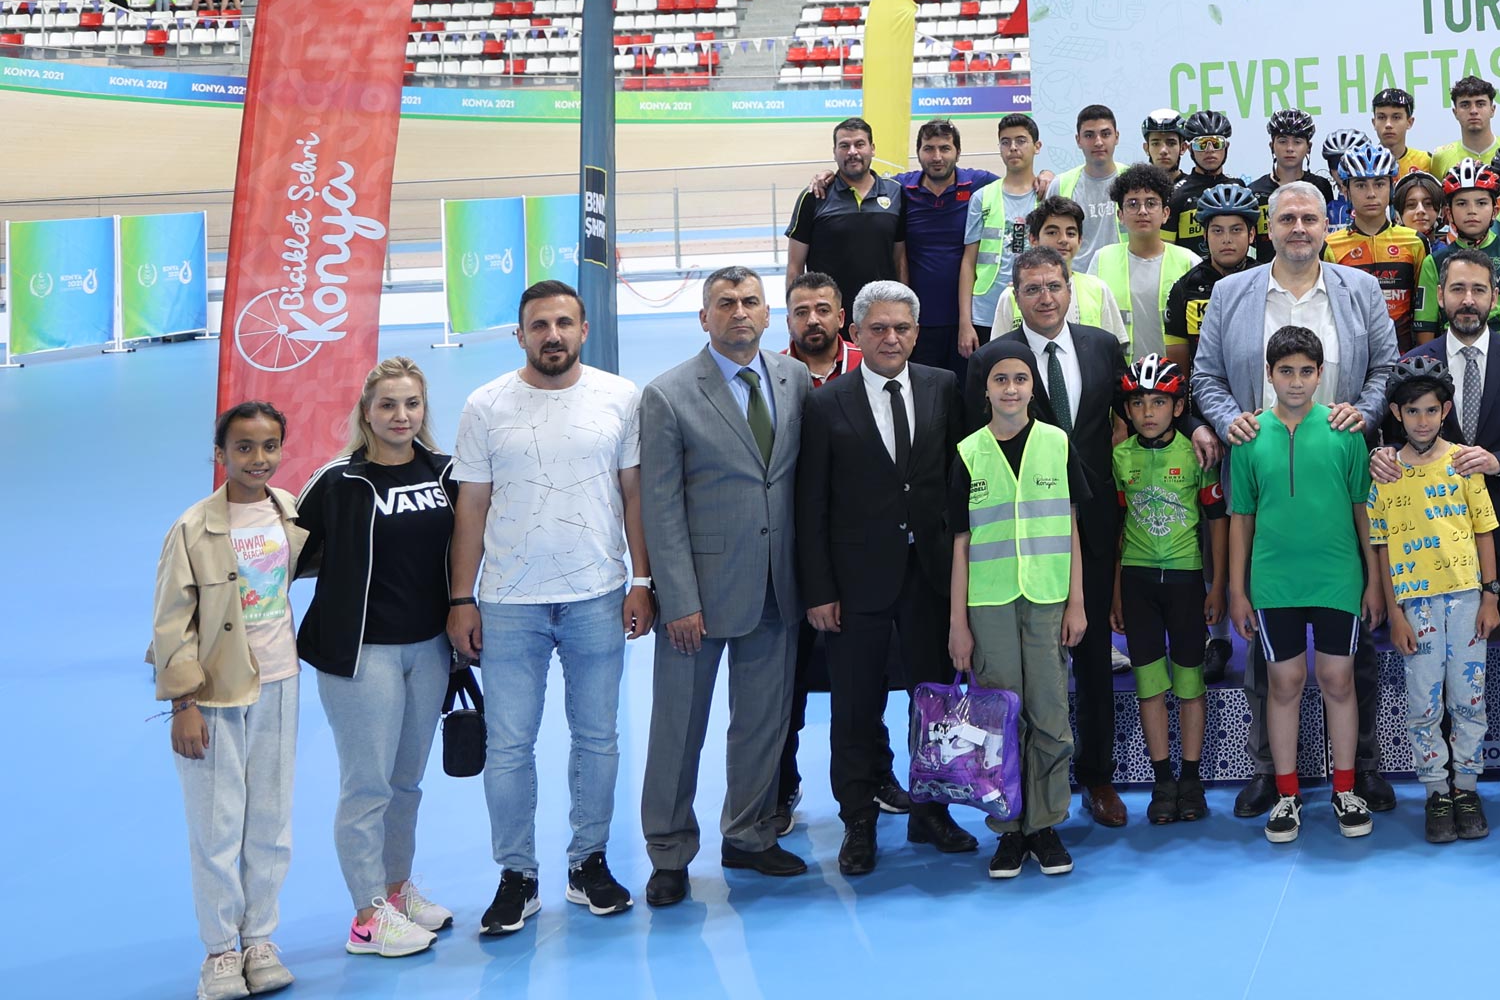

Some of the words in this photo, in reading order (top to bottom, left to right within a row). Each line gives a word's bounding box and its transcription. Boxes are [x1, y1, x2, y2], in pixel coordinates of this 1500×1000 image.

[4, 66, 40, 79] KONYA
[42, 70, 64, 81] 2021
[109, 76, 144, 88] KONYA
[146, 80, 167, 89] 2021
[192, 83, 226, 94] KONYA
[401, 96, 421, 105] 2021
[462, 98, 493, 108] KONYA
[495, 99, 514, 108] 2021
[555, 100, 581, 109] KONY
[640, 102, 671, 110] KONYA
[673, 102, 692, 110] 2021
[732, 101, 764, 110] KONYA
[766, 100, 784, 109] 2021
[825, 99, 857, 108] KONYA
[918, 97, 950, 106] KONYA
[952, 97, 972, 106] 2021
[1012, 94, 1032, 104] KON
[288, 132, 320, 202] Şehri
[287, 160, 387, 342] Konya
[279, 207, 313, 310] Bisiklet
[1424, 483, 1458, 499] HEY
[374, 481, 449, 516] VANS
[1424, 504, 1468, 520] BRAVE
[1388, 520, 1415, 537] OOL
[1403, 536, 1441, 555] DUDE
[1433, 554, 1475, 571] SUPER
